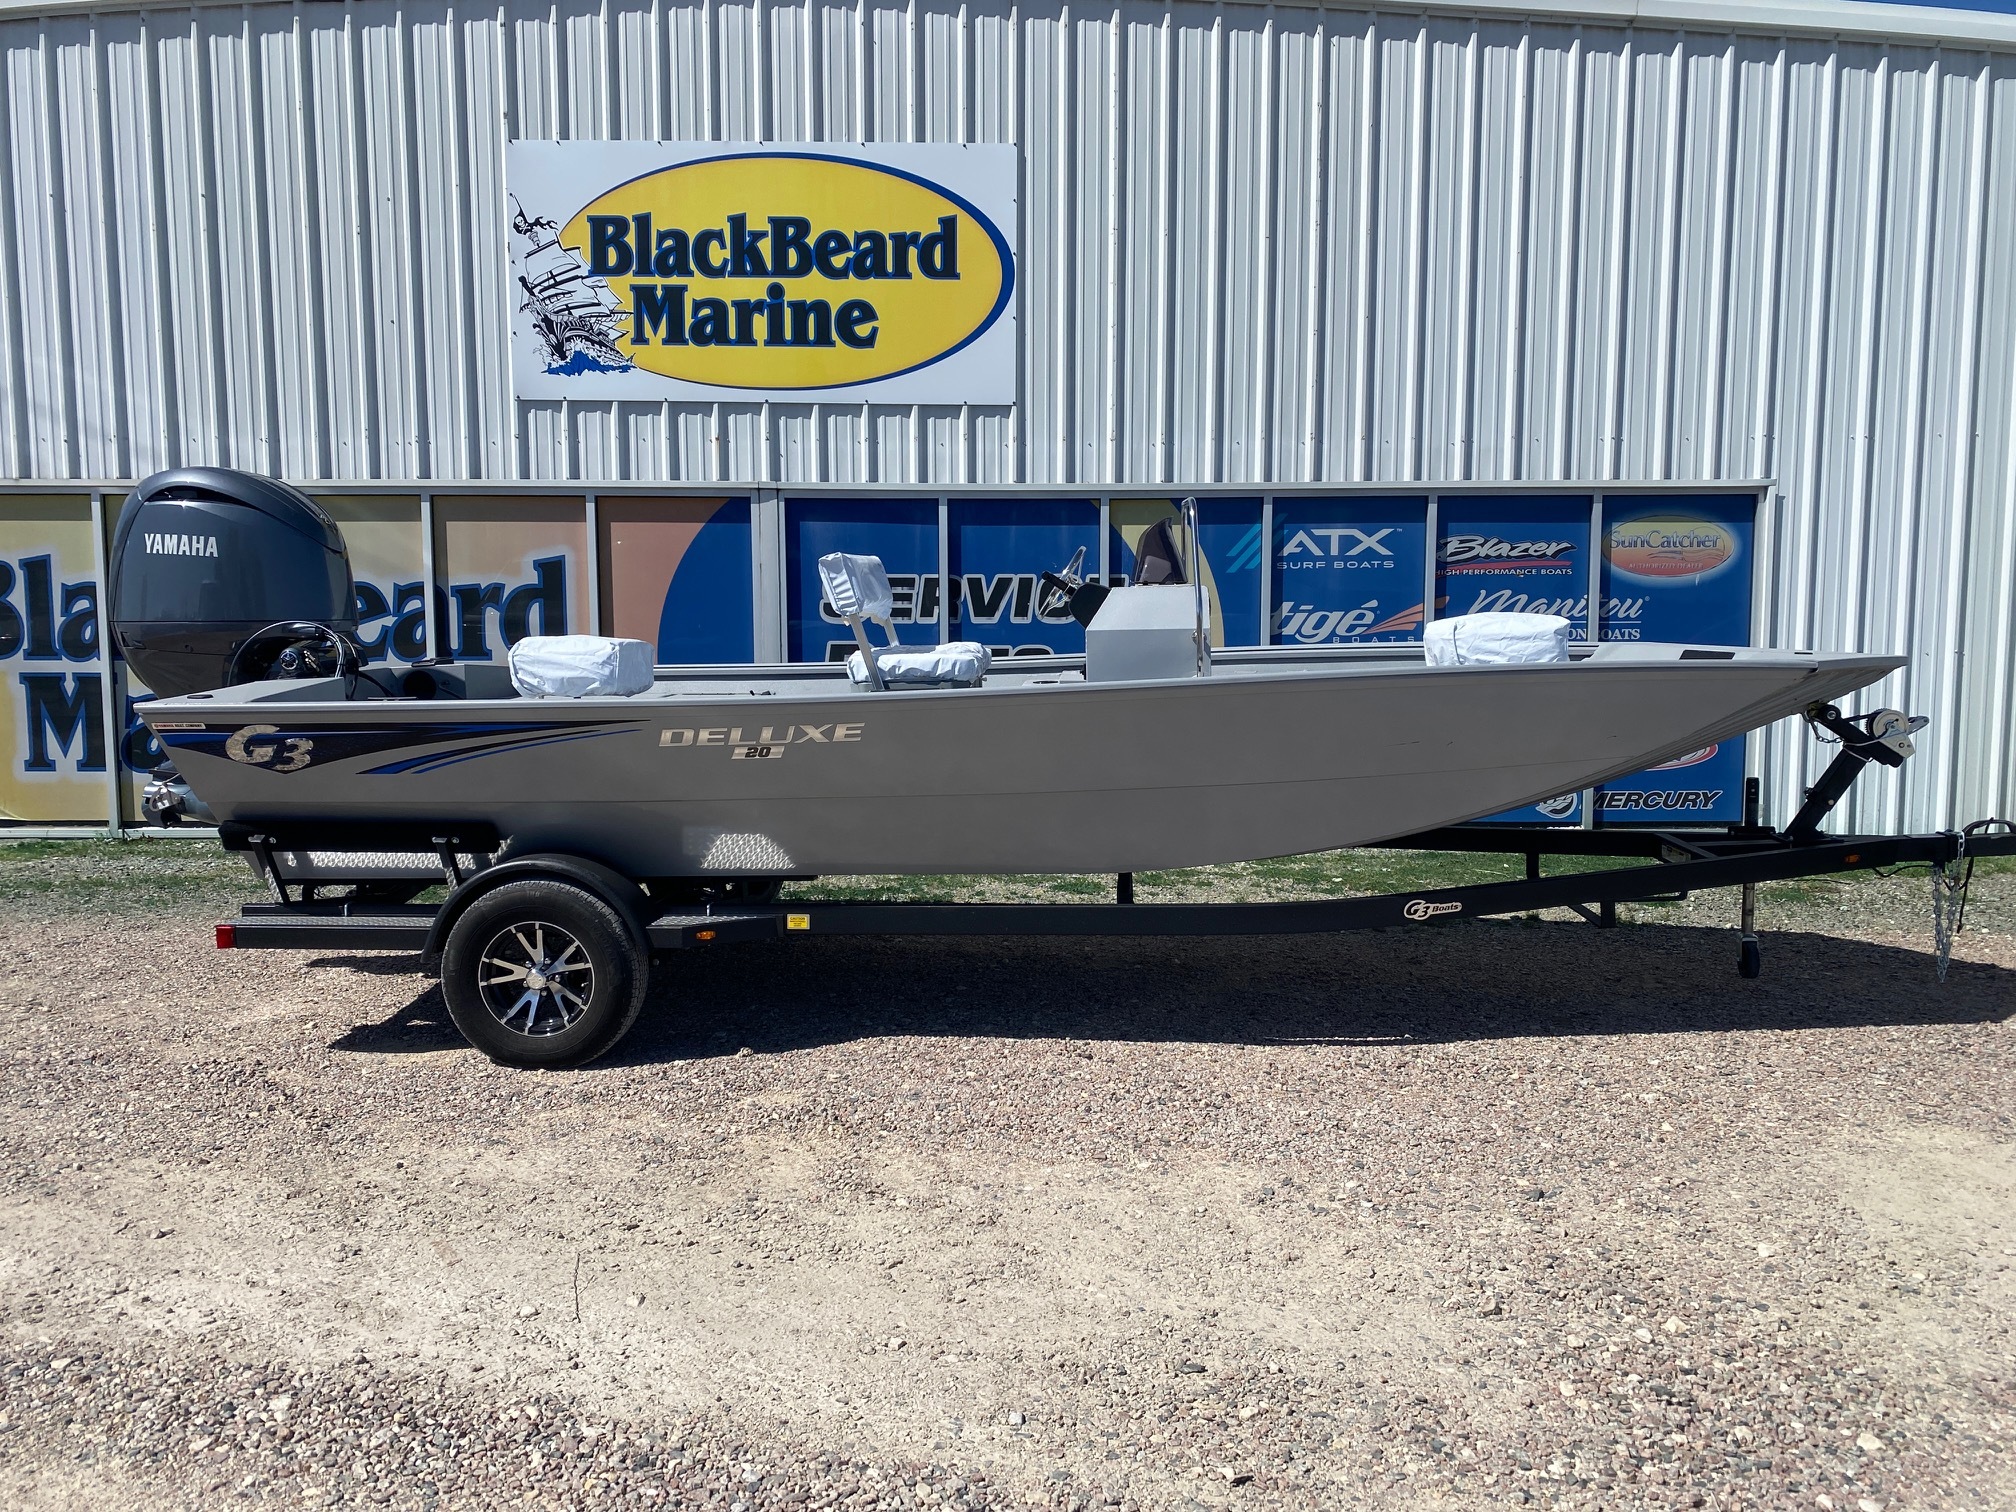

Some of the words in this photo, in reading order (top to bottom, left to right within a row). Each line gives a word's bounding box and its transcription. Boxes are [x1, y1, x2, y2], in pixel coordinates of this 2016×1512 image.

[586, 212, 961, 280] BlackBeard
[629, 282, 879, 348] Marine
[144, 533, 219, 558] YAMAHA
[1277, 528, 1395, 556] ATX
[1439, 533, 1577, 564] Blazer
[1610, 530, 1721, 548] SunCatcher
[1277, 561, 1326, 569] SURF
[1333, 560, 1395, 569] BOATS
[1462, 568, 1537, 576] PERFORMANCE
[658, 722, 865, 747] DELUXE
[225, 724, 314, 771] G3
[744, 746, 772, 759] 20
[1404, 900, 1431, 919] G3
[1431, 903, 1459, 913] Boats
